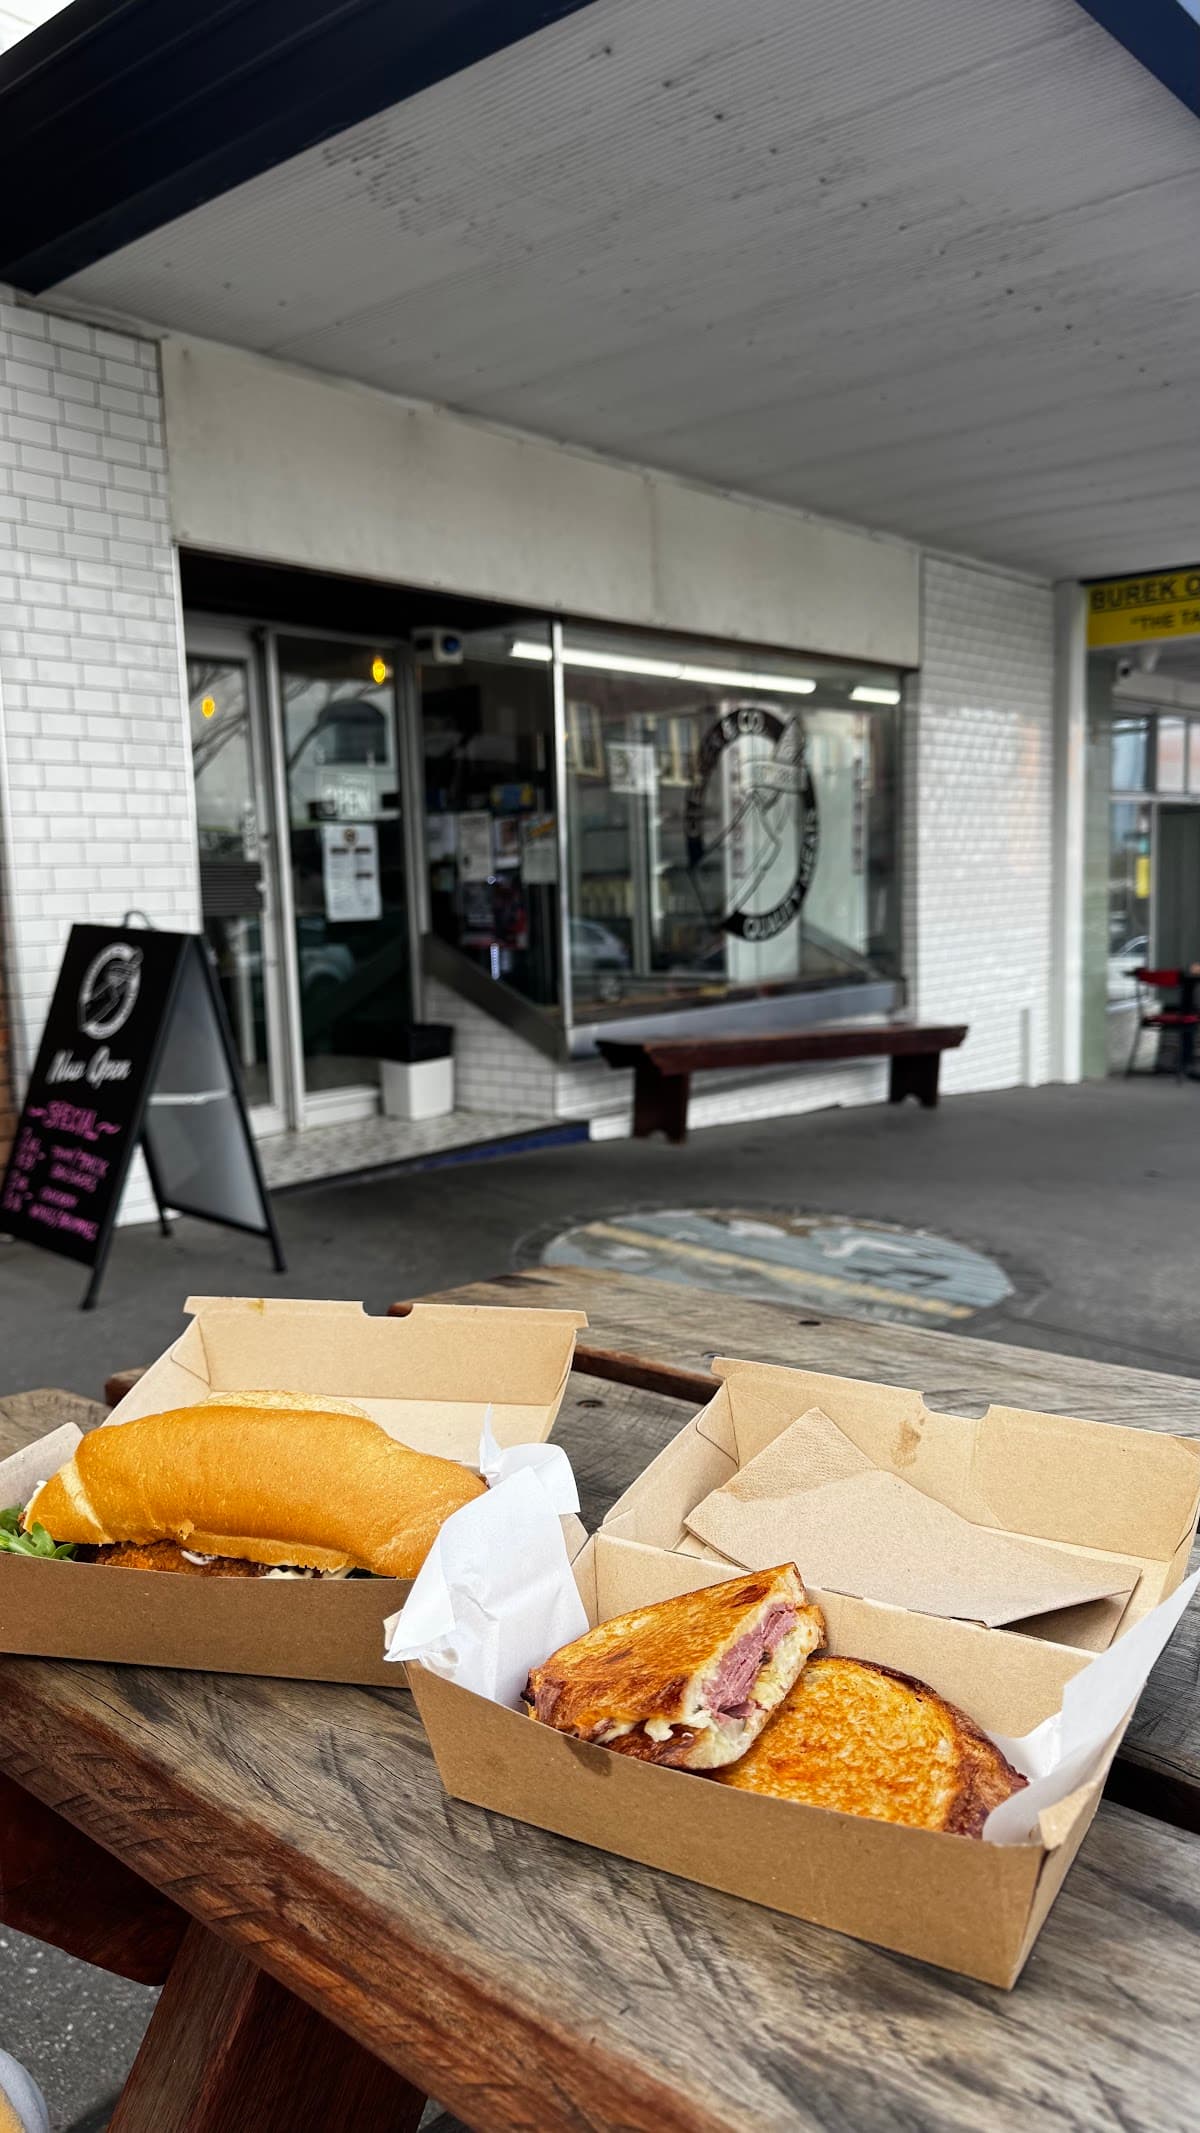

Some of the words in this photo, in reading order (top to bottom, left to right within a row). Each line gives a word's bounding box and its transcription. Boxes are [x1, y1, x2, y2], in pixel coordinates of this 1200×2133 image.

[1089, 576, 1177, 611] BUREK
[47, 1049, 86, 1084] Now
[86, 1046, 132, 1090] Open
